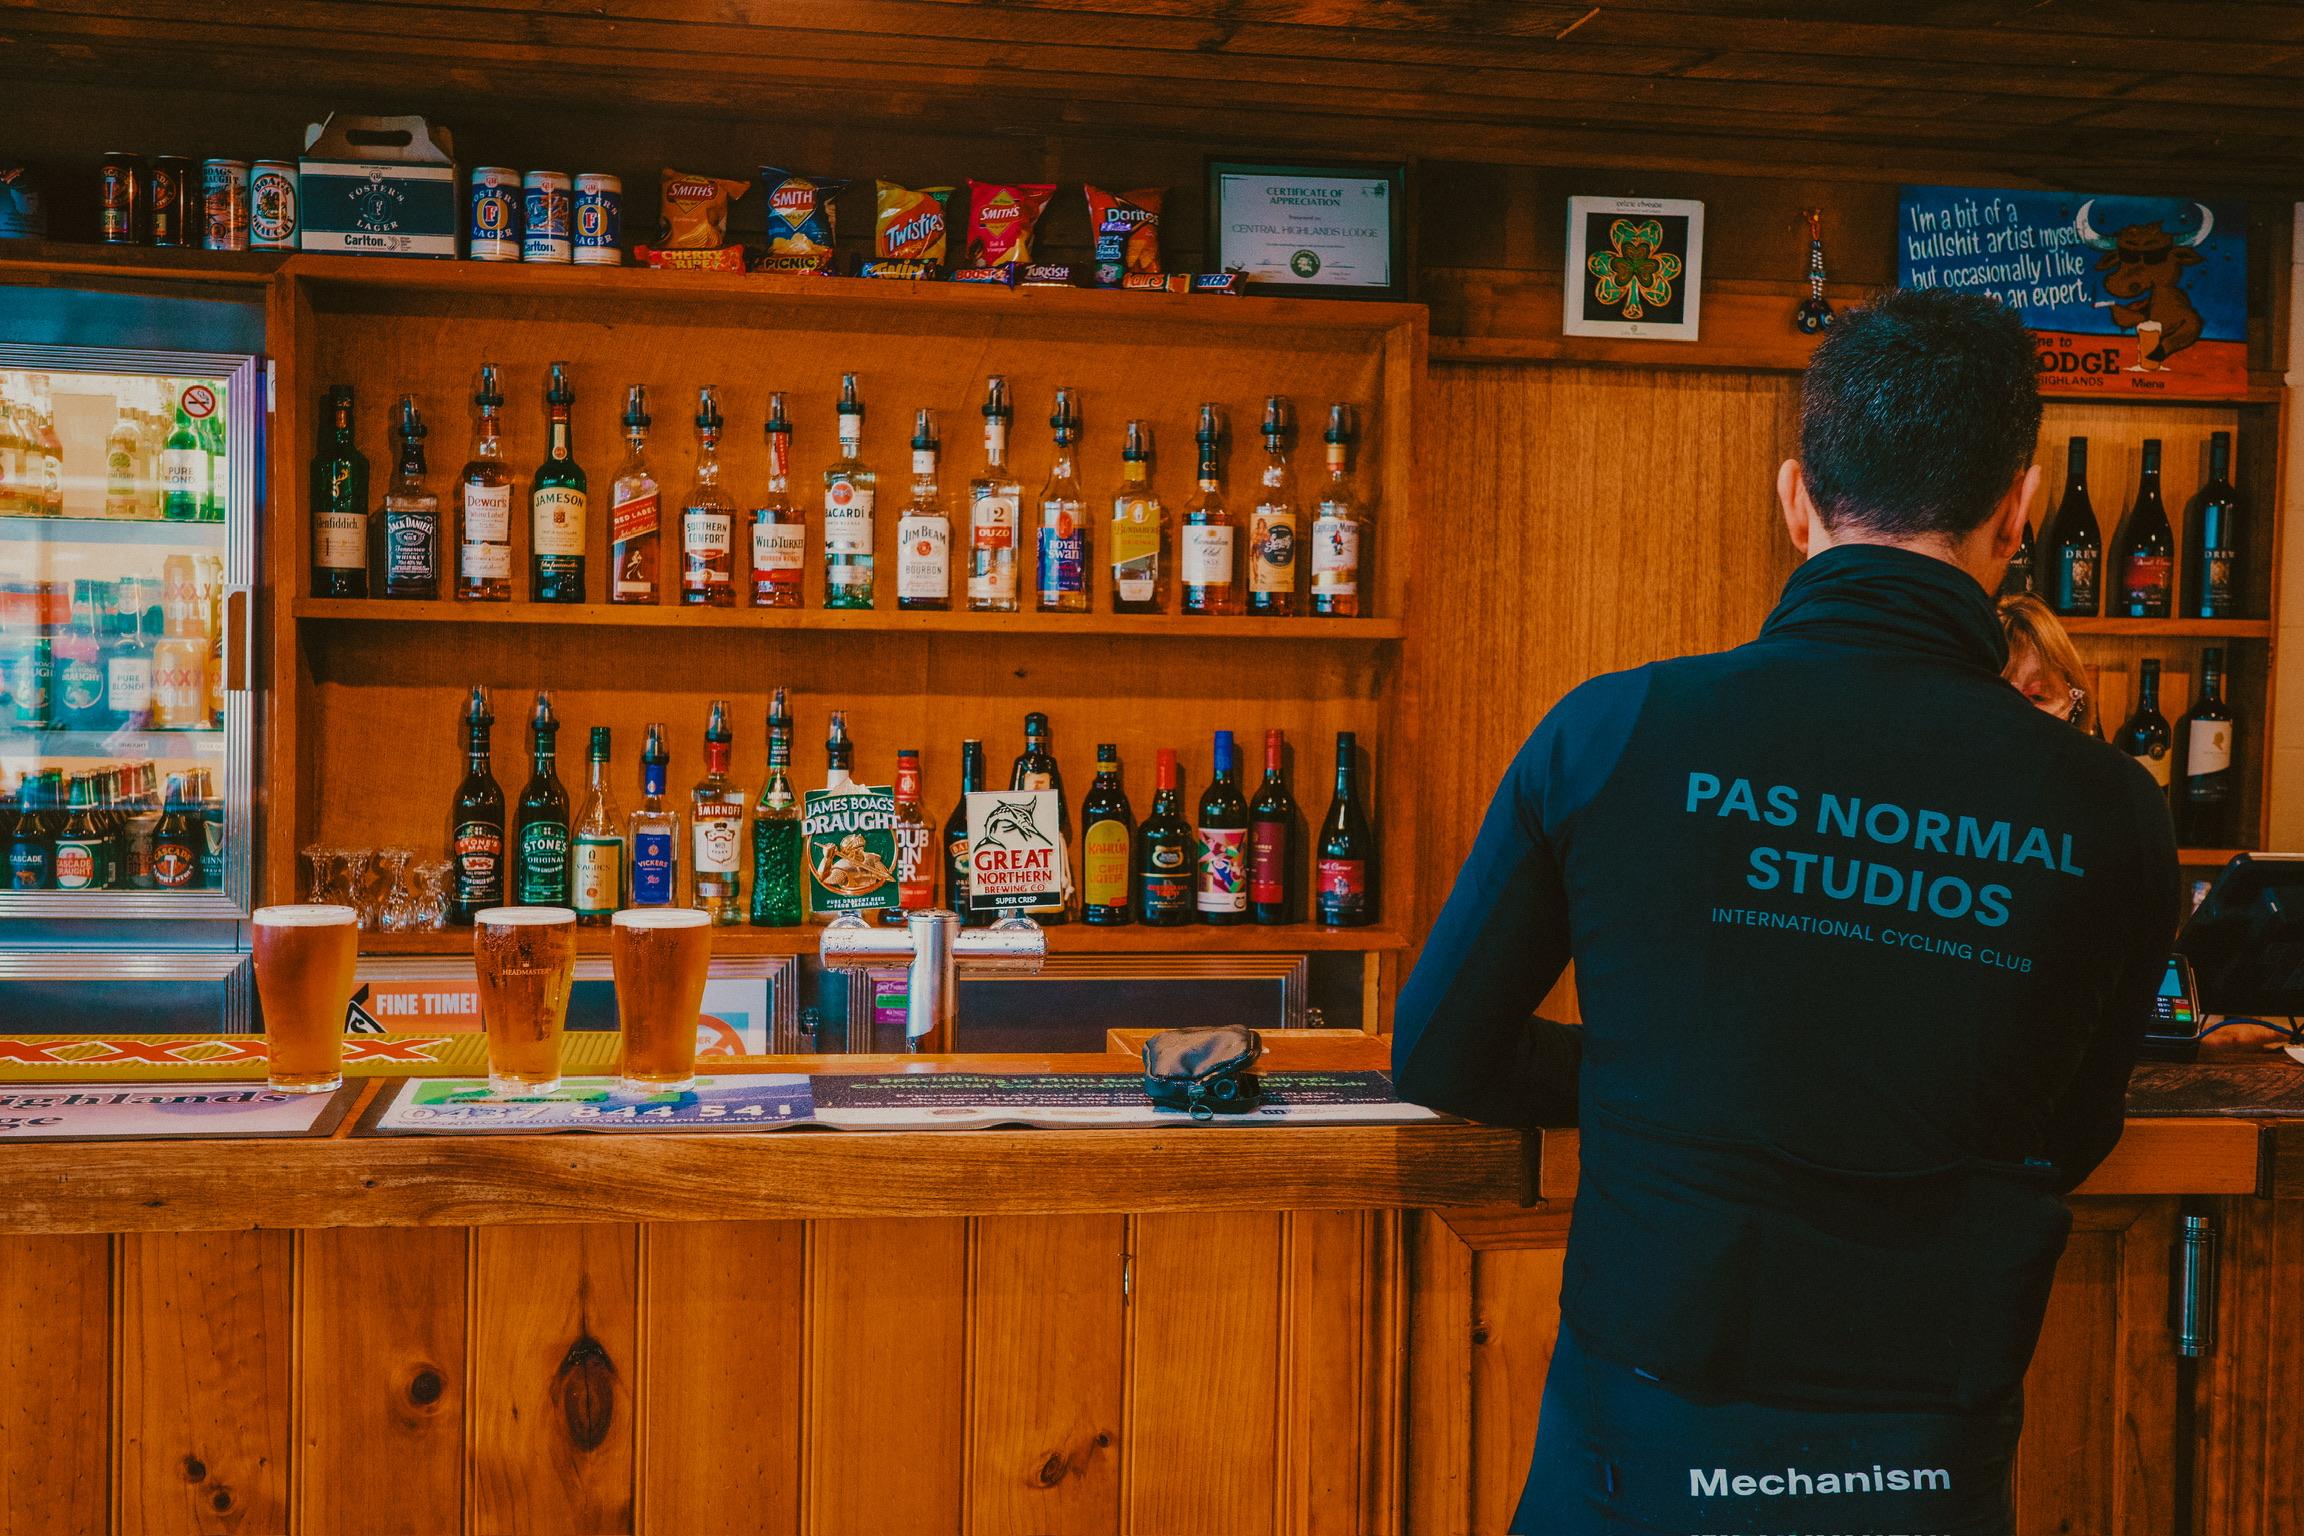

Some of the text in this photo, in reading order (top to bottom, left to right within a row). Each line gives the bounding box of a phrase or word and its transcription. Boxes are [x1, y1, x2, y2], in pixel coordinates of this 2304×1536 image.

[348, 184, 405, 203] FOSTER'S
[669, 183, 715, 198] SMITH'S
[1266, 187, 1344, 198] CERTIFICATE OF
[1269, 196, 1341, 207] APPRECIATION
[484, 205, 498, 222] F
[977, 205, 1019, 222] SMITH'S
[1107, 208, 1159, 226] Doritos
[1910, 197, 2018, 233] I'm a bit of a
[356, 219, 398, 232] LAGER
[472, 226, 512, 239] LAGER
[884, 212, 944, 252] Twisties
[1232, 224, 1379, 239] CENTRAL HIGHLANDS LODGE
[1908, 230, 1982, 262] bullshit
[1986, 224, 2035, 254] artist
[661, 250, 726, 261] CHERRY
[675, 260, 708, 269] RIPE
[765, 257, 816, 270] PICNIC
[1911, 265, 1937, 290] but
[1943, 252, 2041, 288] occasionally
[2055, 251, 2084, 276] like
[955, 268, 1003, 281] BOOST
[1023, 264, 1068, 278] TURKISH
[2006, 288, 2030, 309] an
[2032, 278, 2092, 311] expert.
[2060, 338, 2073, 348] to
[2131, 378, 2165, 388] Miena
[168, 466, 193, 475] PURE
[1202, 463, 1217, 472] CC
[534, 494, 584, 508] JAMESON
[614, 506, 656, 524] RED LABEL
[388, 516, 433, 534] JACK DANIEL'S
[687, 521, 727, 532] SOUTHERN
[688, 533, 725, 544] COMFORT
[902, 526, 947, 545] JIM BEAM
[978, 529, 1010, 538] OUZO
[755, 535, 776, 549] WILD
[1048, 539, 1081, 551] ROYAL
[1047, 550, 1080, 561] swan
[905, 565, 942, 574] BOURBON
[698, 806, 741, 817] SMIRNOFF
[808, 796, 895, 818] JAMES BOAG'S
[801, 813, 900, 837] DRAUGHT
[1685, 771, 2087, 877] PAS NORMAL
[459, 839, 499, 849] STONE'S
[523, 839, 567, 854] STONE'S
[154, 843, 193, 862] CASCADE
[974, 847, 1054, 871] GREAT
[56, 861, 93, 869] CASCADE
[527, 856, 564, 864] ORIGINAL
[637, 858, 668, 869] VICKERS
[977, 870, 1052, 885] NORTHERN
[984, 884, 1045, 894] BREWING CO
[1745, 846, 2013, 928] STUDIOS
[995, 895, 1038, 905] SUPER CRISP
[1711, 907, 2034, 974] INTERNATIONAL CYCLING CLUB
[502, 967, 548, 976] HEADMASTER
[376, 992, 478, 1015] FINE TIME!
[566, 1103, 674, 1118] 844
[698, 1103, 791, 1117] 541
[1690, 1464, 1952, 1497] Mechanism
